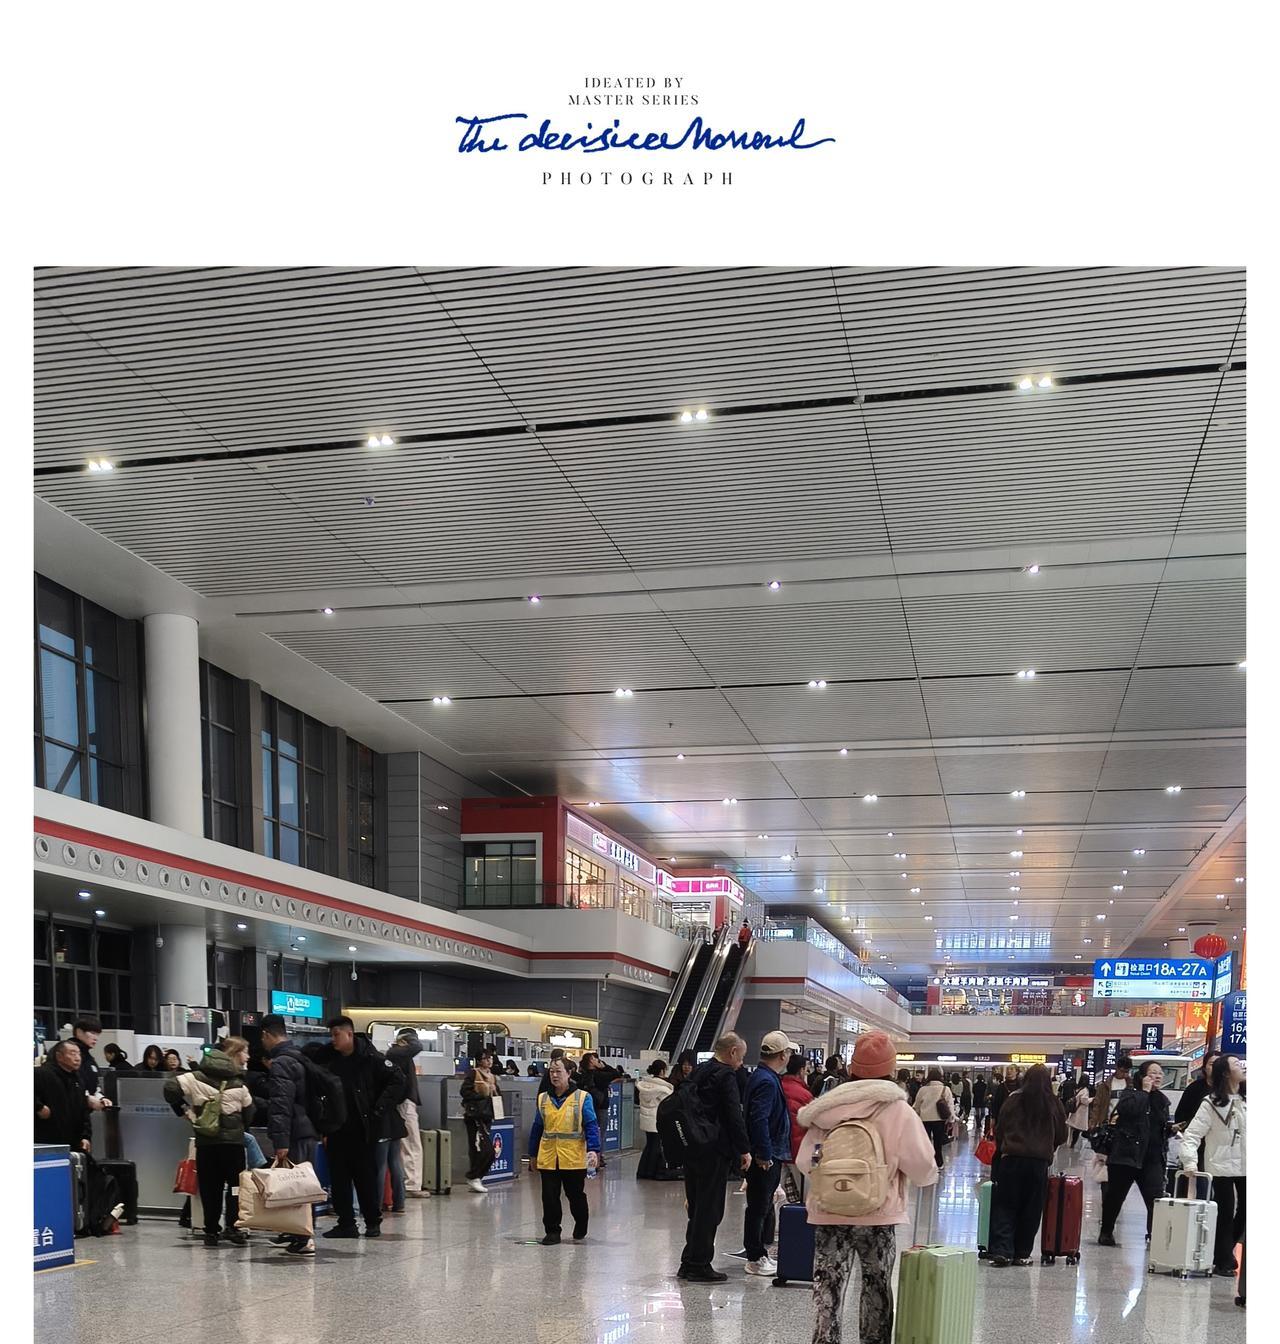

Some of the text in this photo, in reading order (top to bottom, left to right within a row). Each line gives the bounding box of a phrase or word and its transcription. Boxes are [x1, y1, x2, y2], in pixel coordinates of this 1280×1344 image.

[1130, 963, 1153, 972] 检票口
[1153, 962, 1207, 976] 18A-27A
